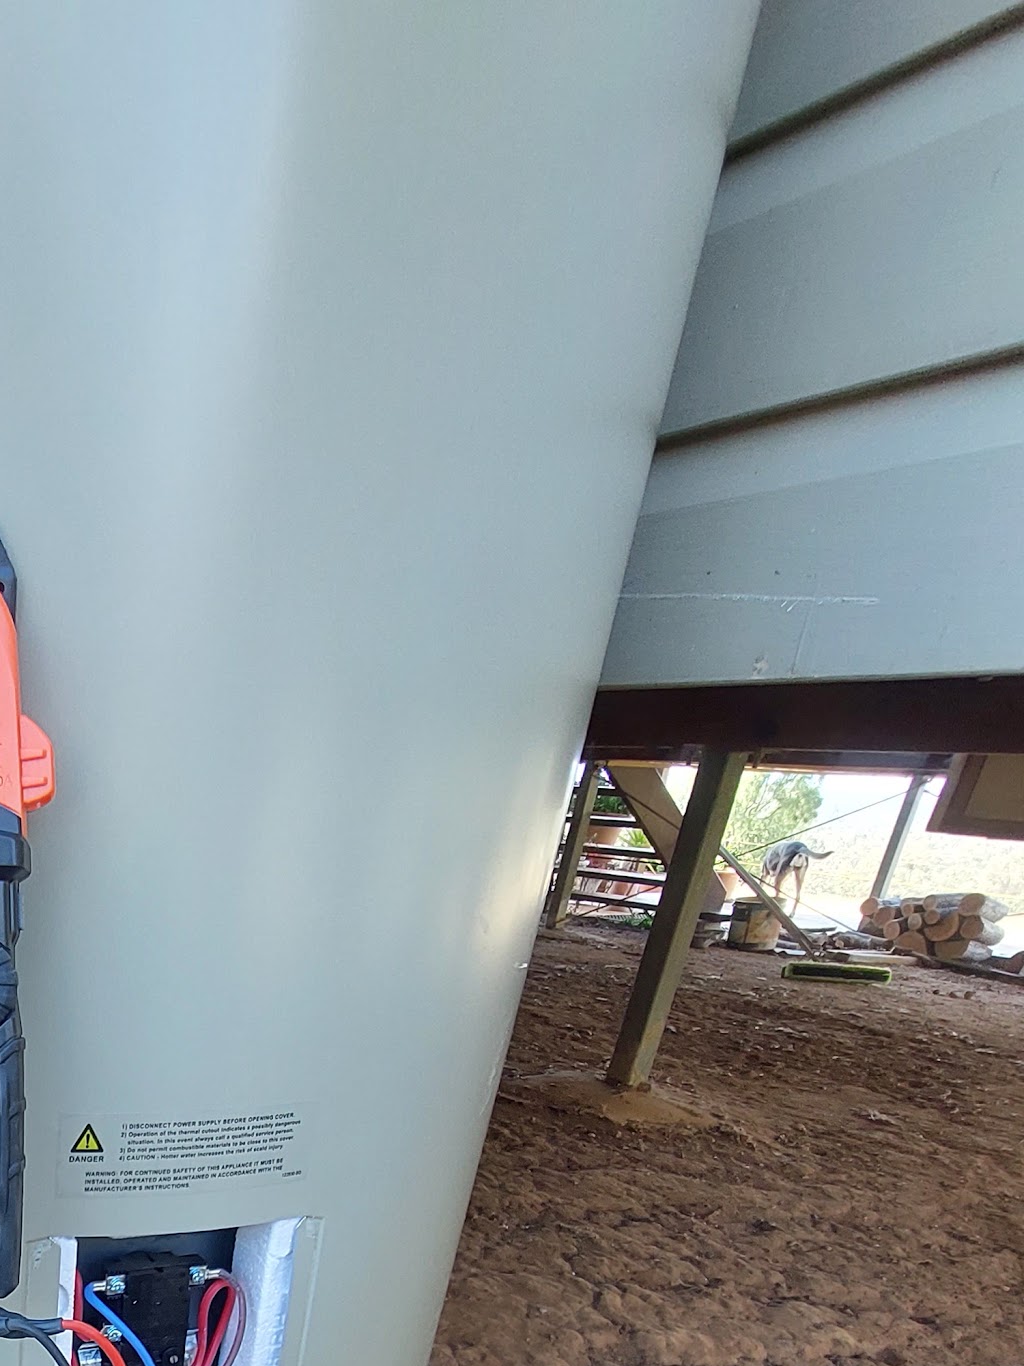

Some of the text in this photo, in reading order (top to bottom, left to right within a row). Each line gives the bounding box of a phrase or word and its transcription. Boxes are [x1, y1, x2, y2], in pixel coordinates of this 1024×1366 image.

[248, 1114, 274, 1122] OPENING
[252, 1123, 273, 1131] possibly
[232, 1132, 255, 1140] qualified
[135, 1168, 171, 1176] CONTINUED
[221, 1162, 253, 1170] APPLIANCE
[260, 1158, 275, 1166] MUST
[218, 1168, 256, 1178] ACCORDANCE
